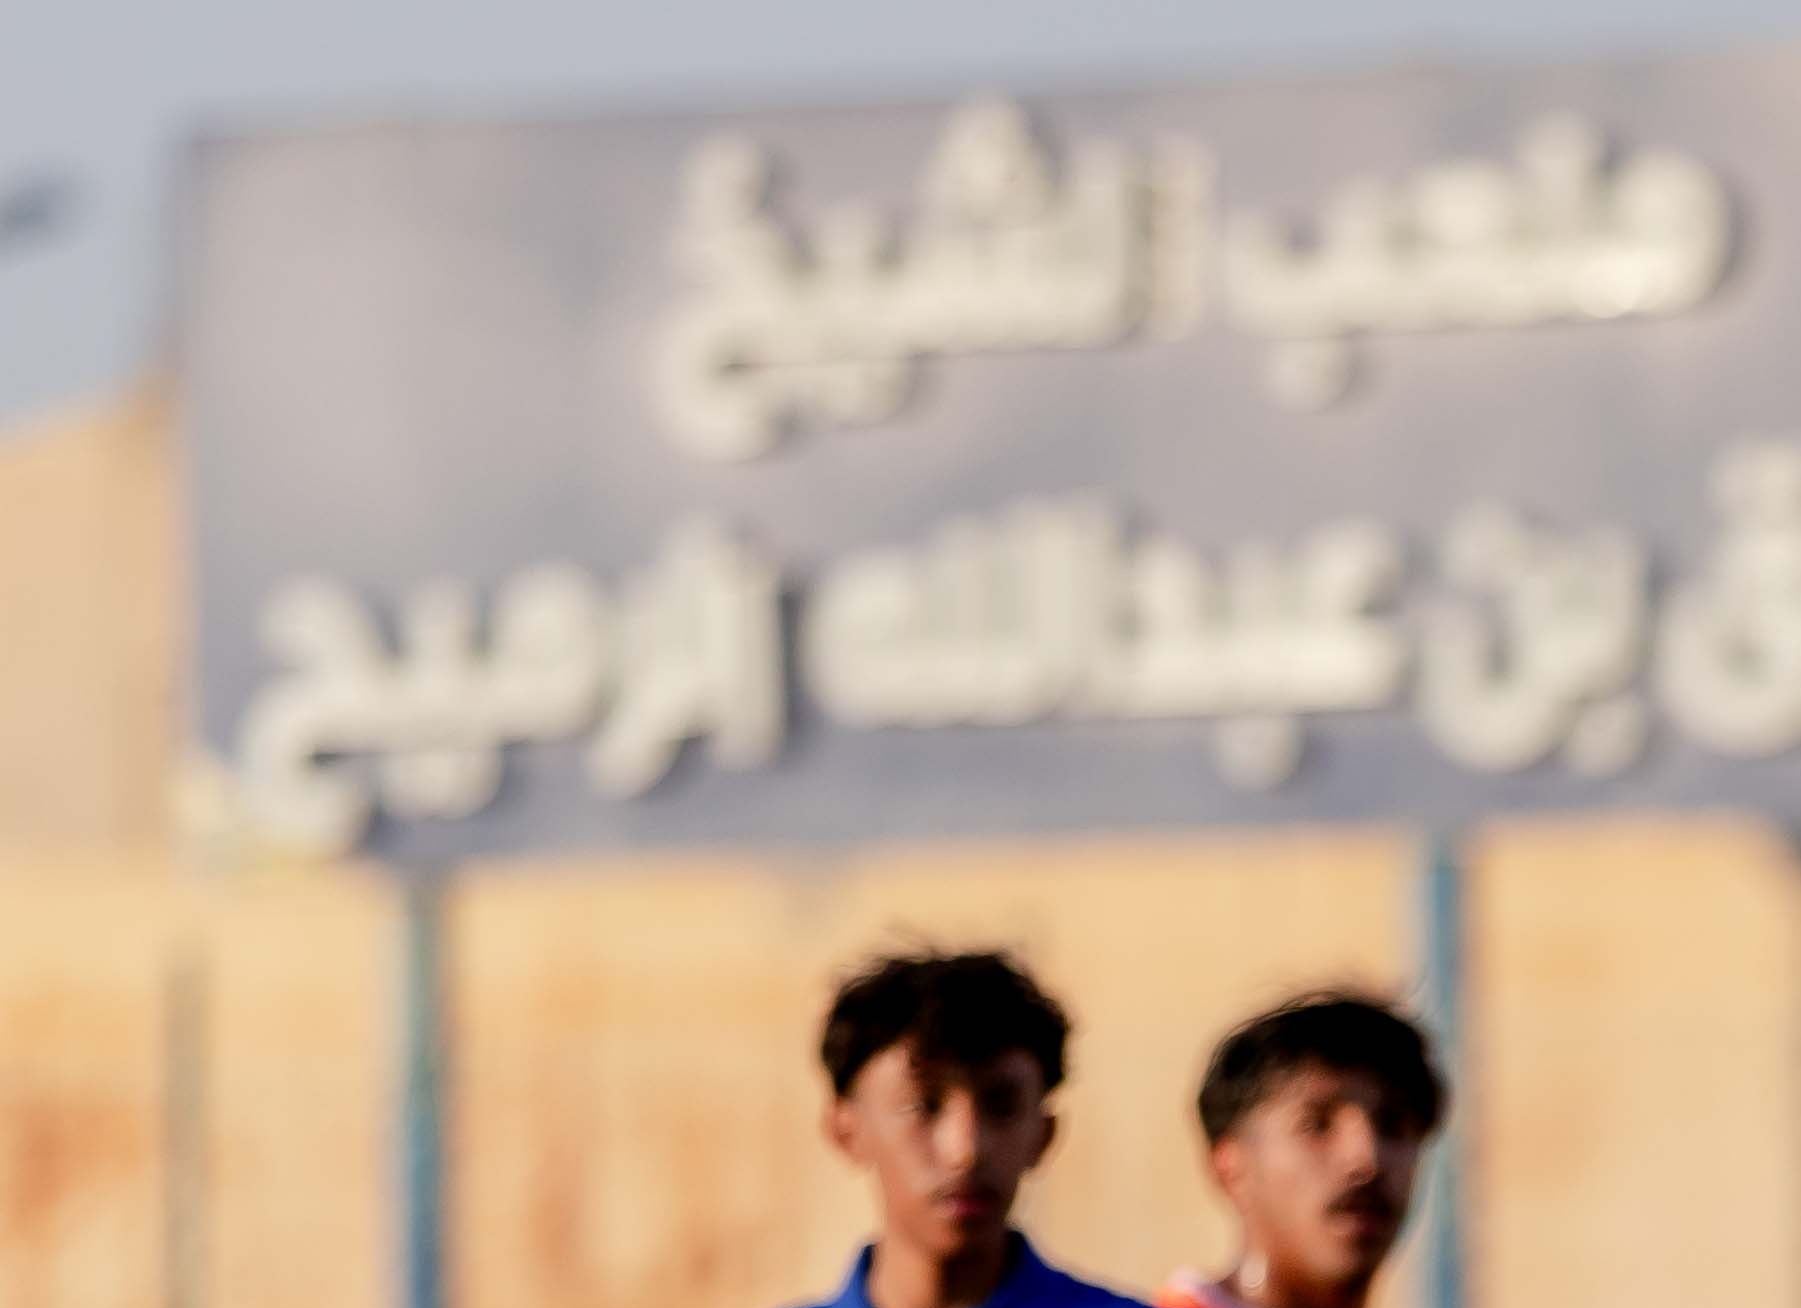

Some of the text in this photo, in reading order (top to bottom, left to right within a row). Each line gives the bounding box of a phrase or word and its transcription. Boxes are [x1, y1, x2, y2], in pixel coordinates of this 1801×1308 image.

[655, 95, 1728, 462] ملعب الشيخ
[1418, 500, 1645, 775] بن
